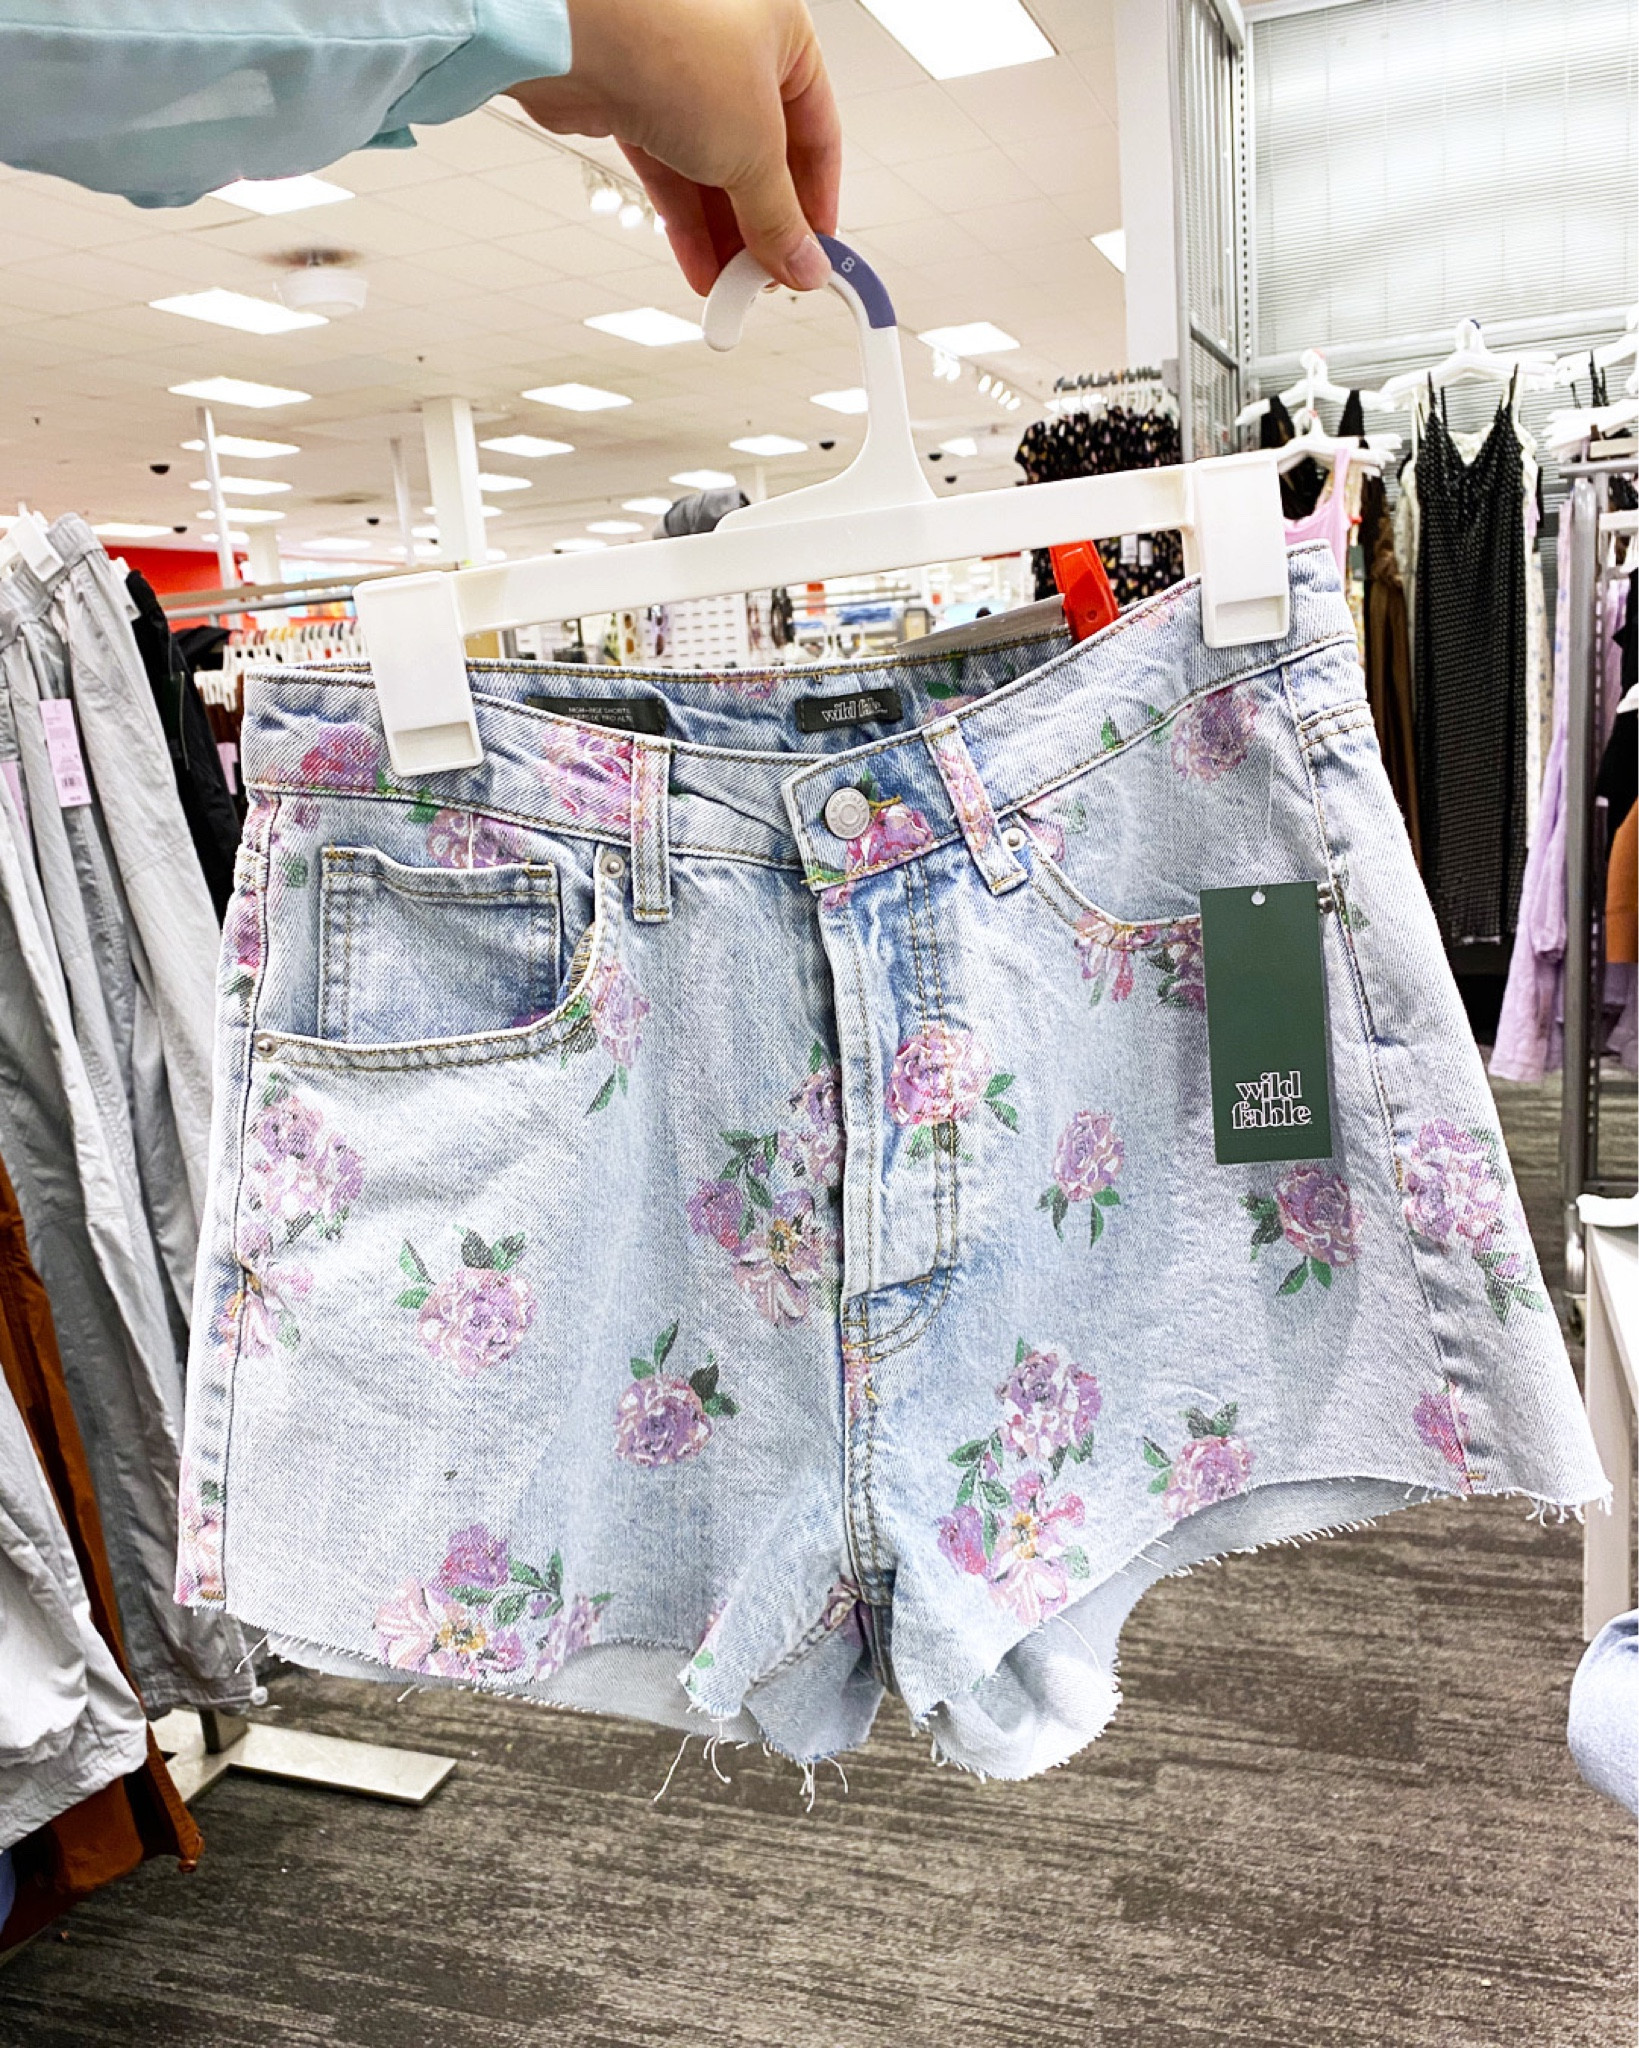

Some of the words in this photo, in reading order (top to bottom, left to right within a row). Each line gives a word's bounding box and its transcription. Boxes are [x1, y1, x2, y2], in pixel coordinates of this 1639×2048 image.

[841, 256, 855, 273] 8
[821, 700, 857, 722] wild
[1235, 1070, 1302, 1101] wild
[1231, 1096, 1311, 1130] fable
